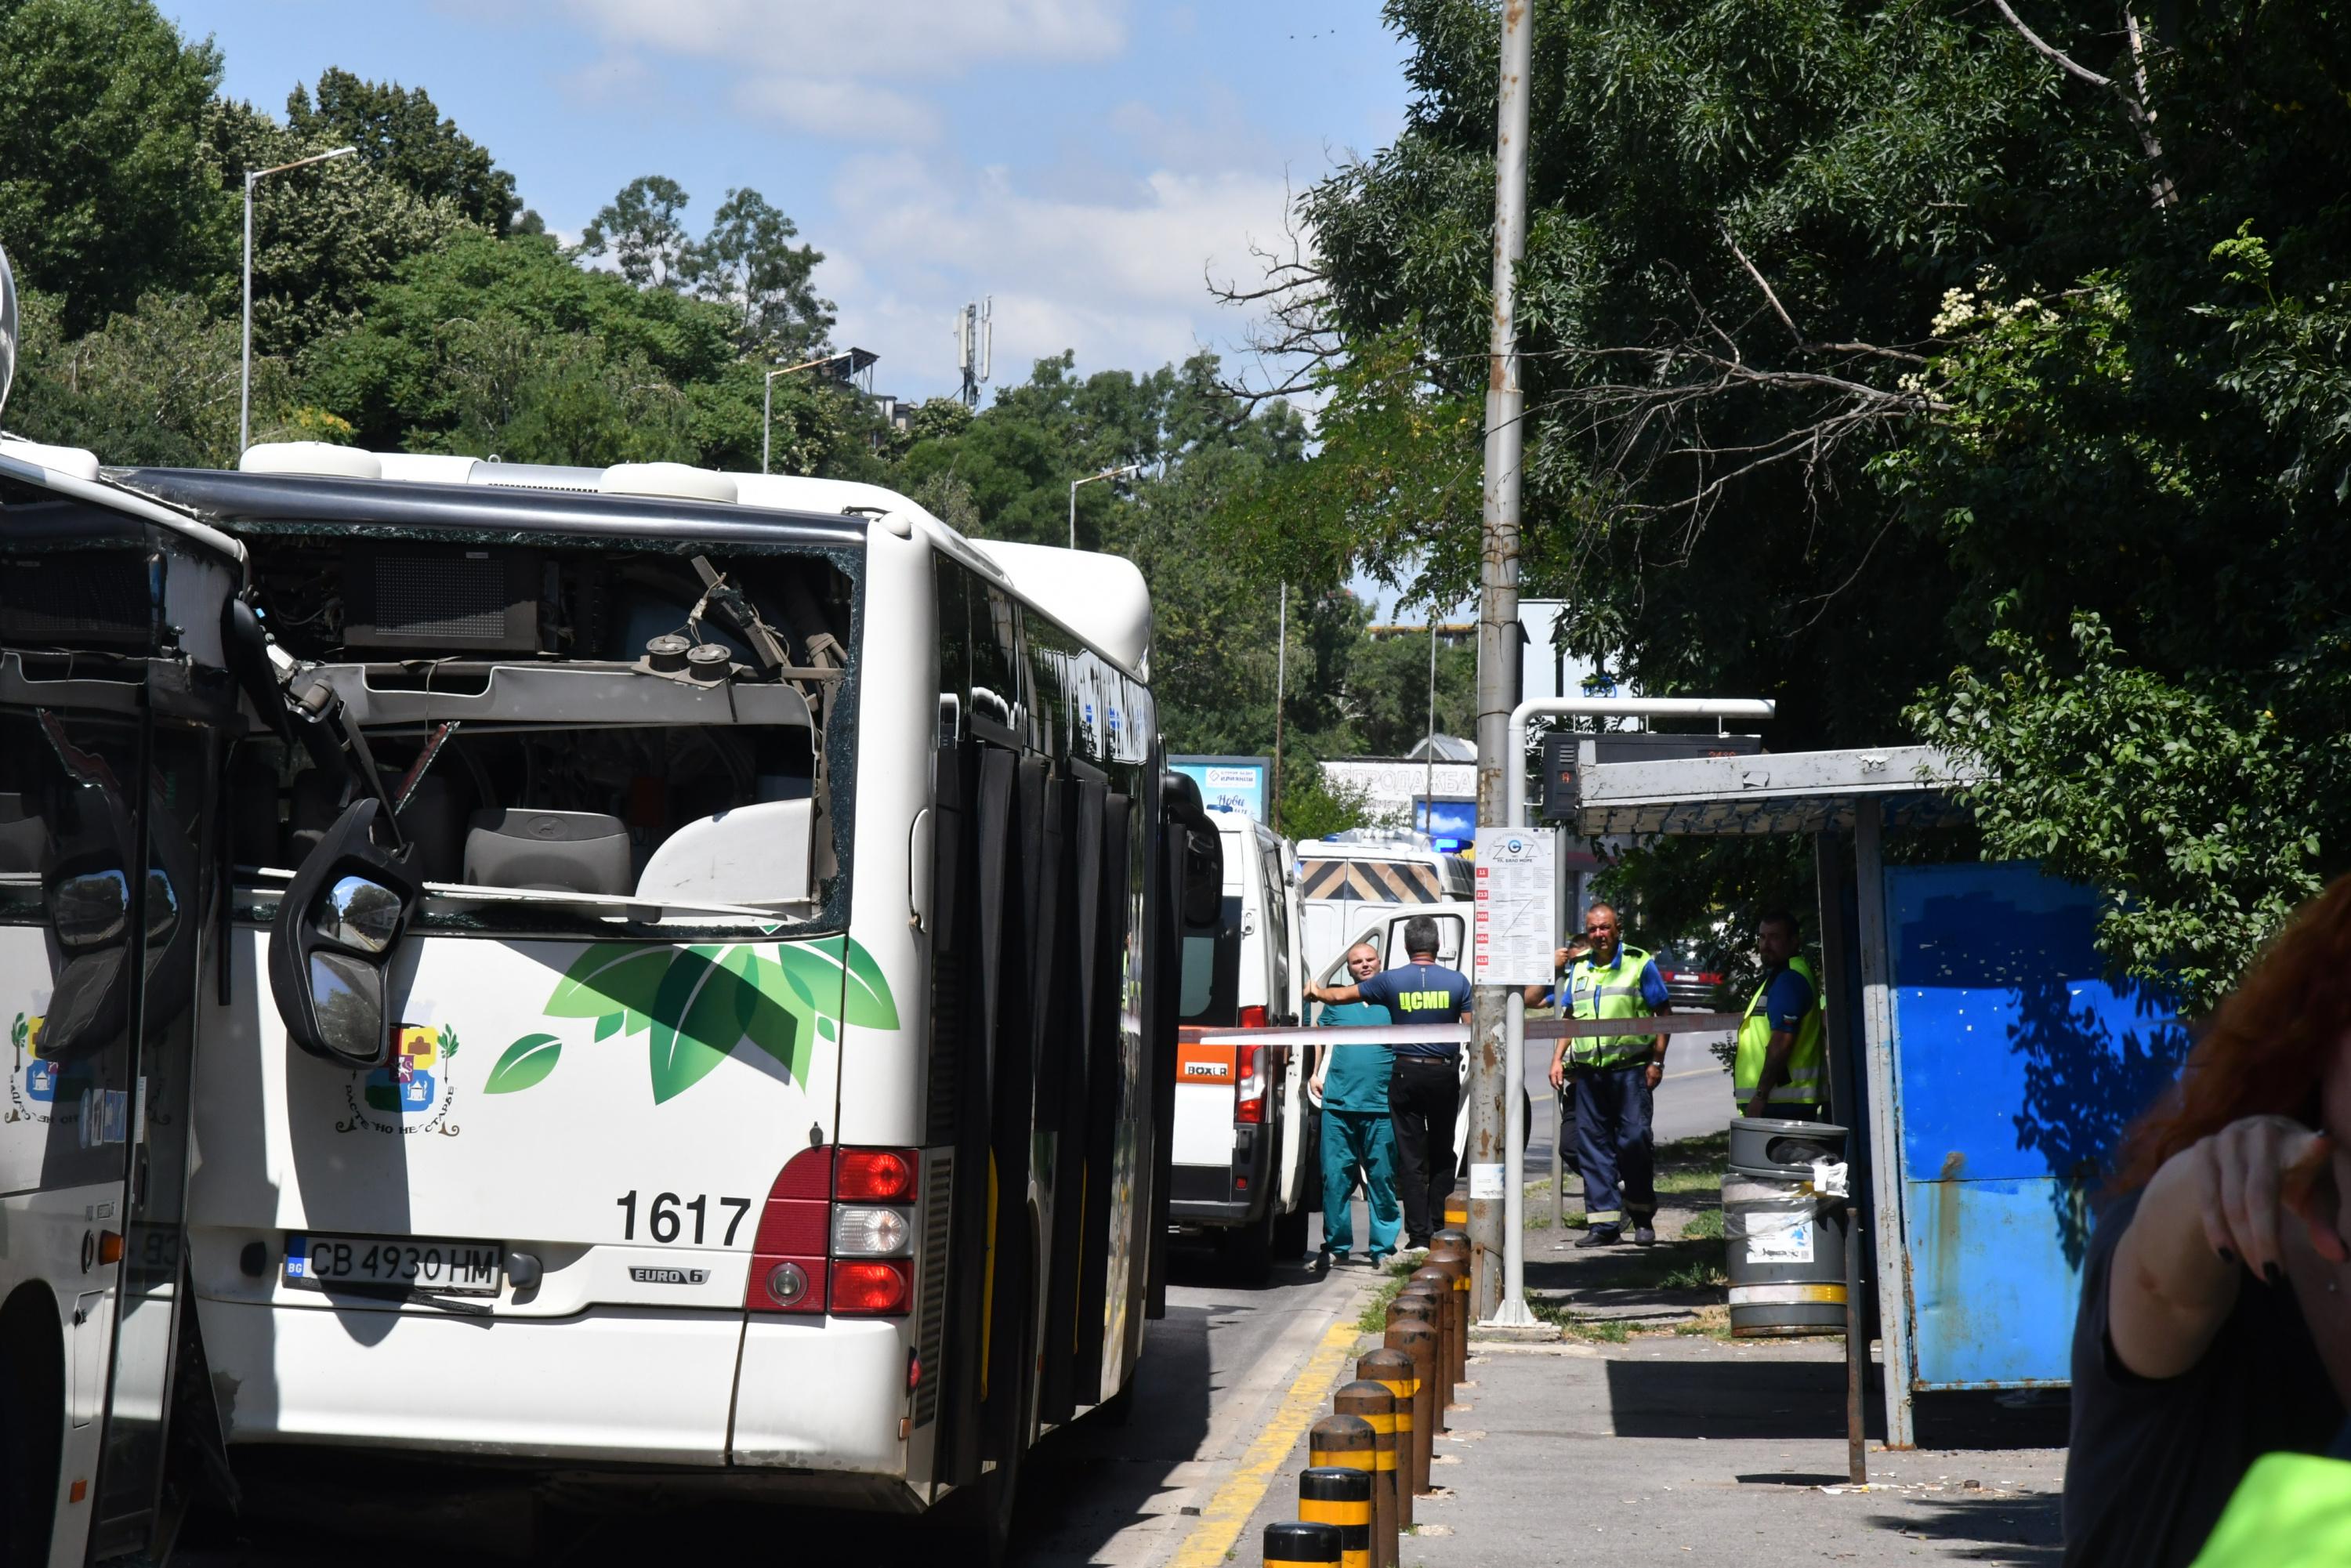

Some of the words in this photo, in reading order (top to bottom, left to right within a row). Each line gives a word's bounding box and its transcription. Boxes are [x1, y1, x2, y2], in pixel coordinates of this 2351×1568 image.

[1217, 794, 1245, 807] Нови
[1399, 990, 1450, 1012] ЦСМП
[375, 1124, 393, 1135] НО
[399, 1126, 418, 1135] НЕ
[616, 1190, 752, 1247] 1617
[288, 1263, 302, 1273] BG
[311, 1242, 352, 1276] CB
[361, 1245, 440, 1280] 4930
[448, 1249, 494, 1284] HM
[635, 1269, 680, 1282] EURO
[690, 1269, 703, 1282] 6
